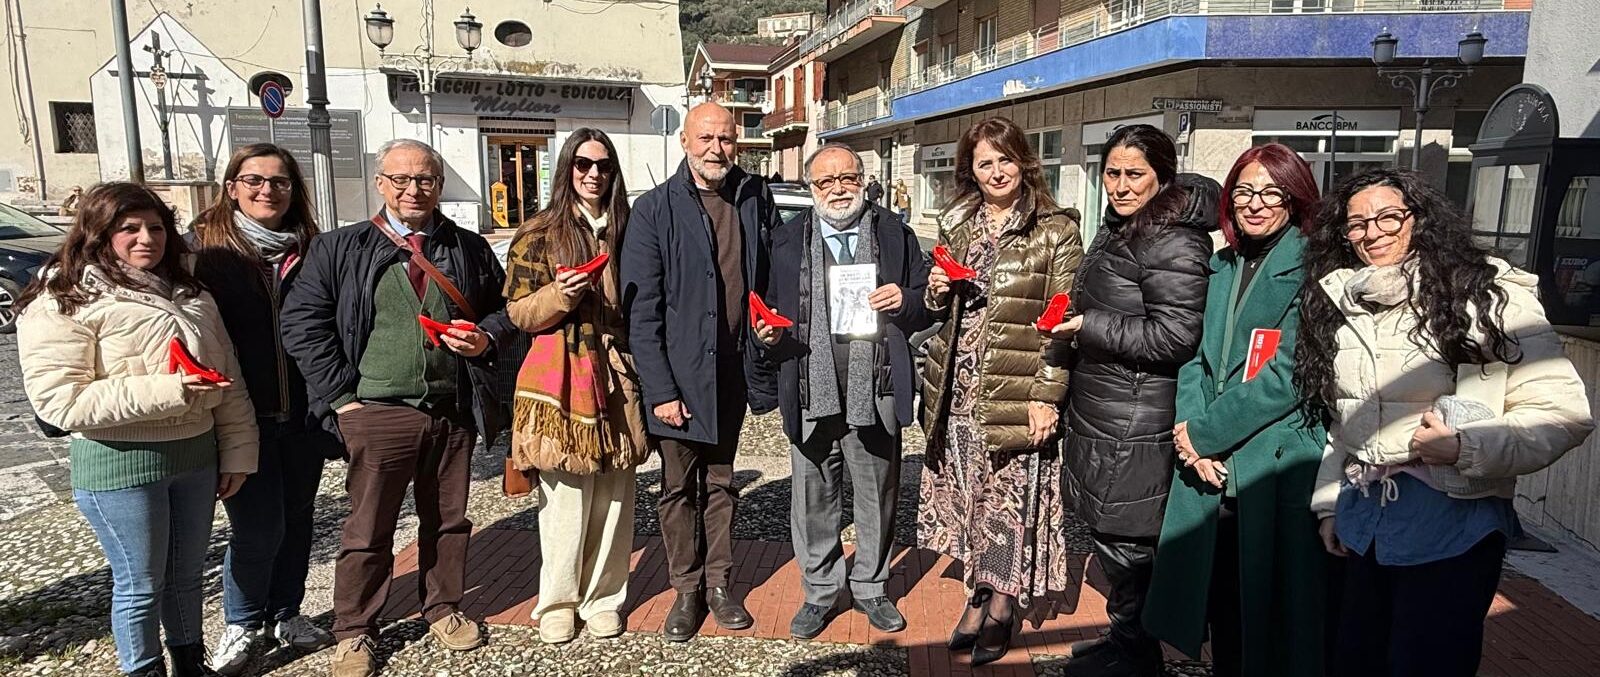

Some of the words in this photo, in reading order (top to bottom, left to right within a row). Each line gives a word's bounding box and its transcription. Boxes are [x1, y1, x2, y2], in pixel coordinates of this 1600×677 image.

[496, 80, 545, 97] LOTTO
[471, 95, 562, 116] Migliore
[1175, 102, 1222, 111] PASSIONISTI
[1180, 115, 1187, 130] P
[1336, 121, 1358, 130] BPM
